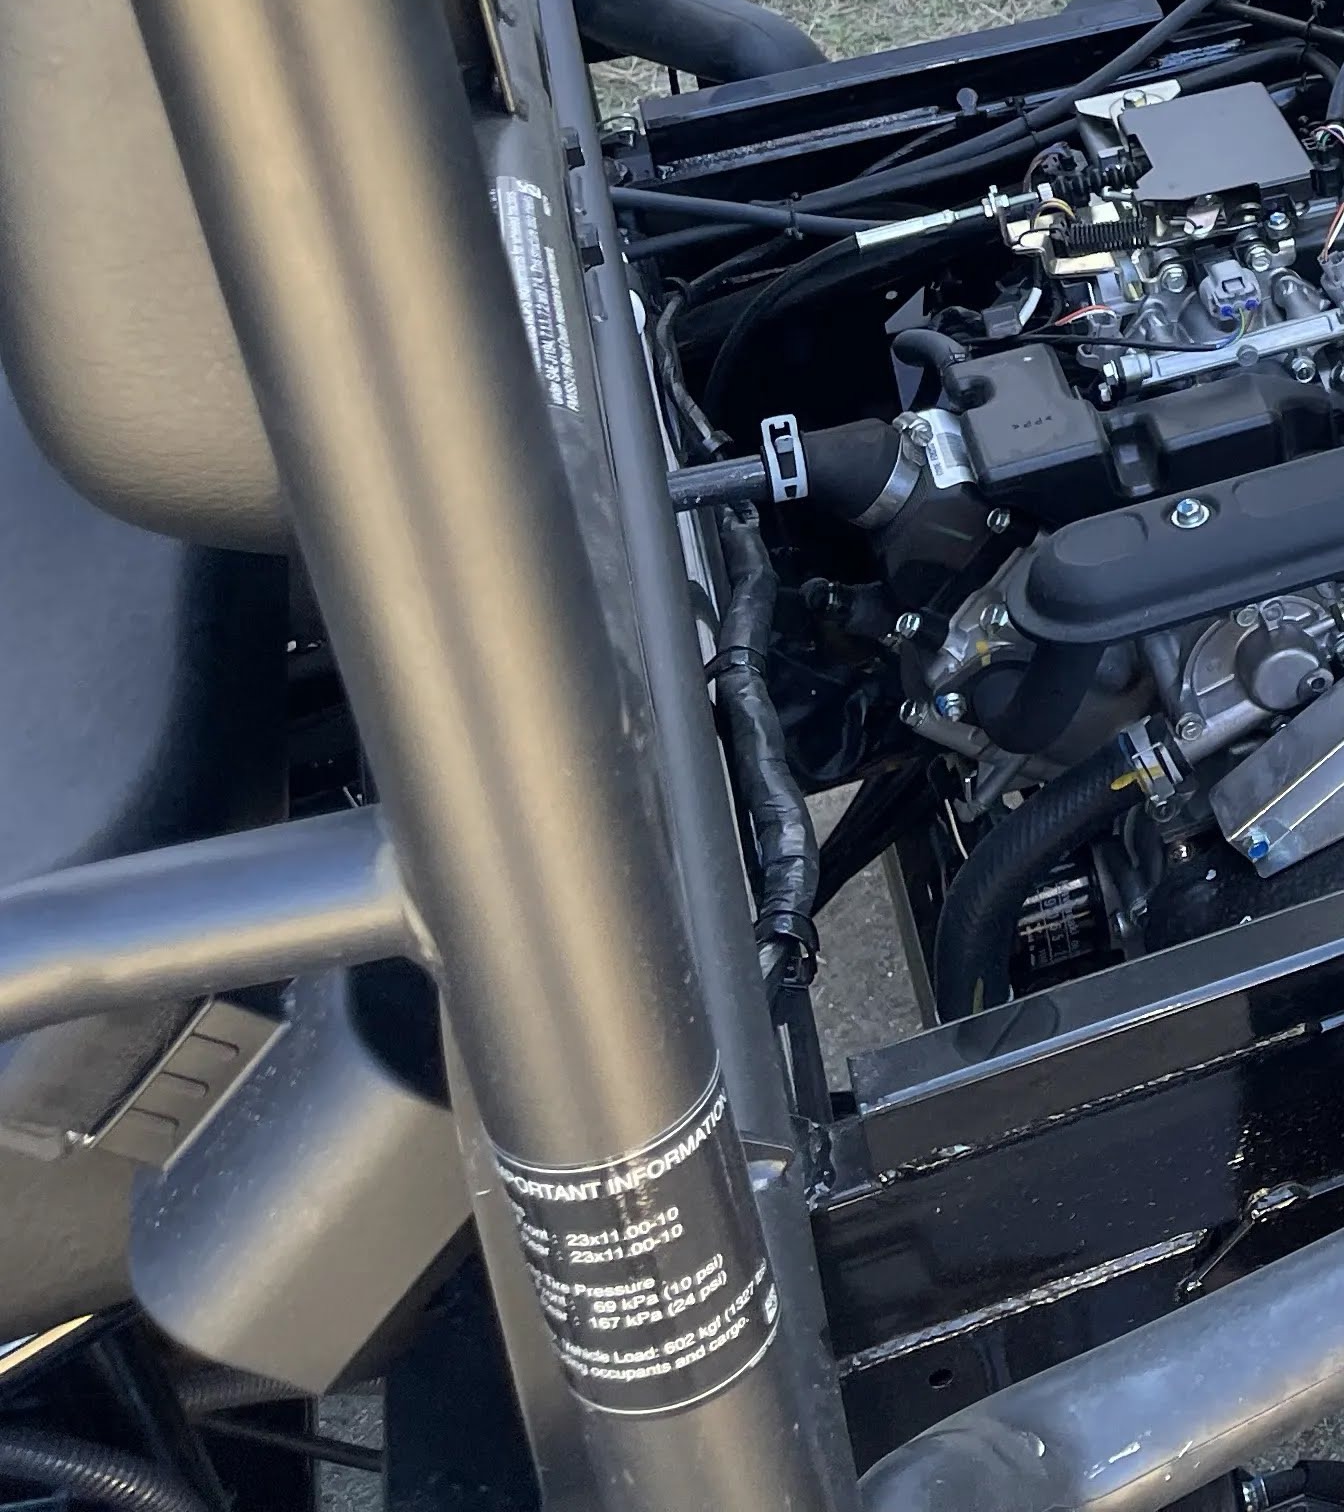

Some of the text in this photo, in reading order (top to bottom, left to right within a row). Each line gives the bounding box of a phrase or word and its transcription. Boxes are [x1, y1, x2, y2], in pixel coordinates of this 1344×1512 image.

[498, 1165, 602, 1201] PORTANT
[565, 1206, 680, 1247] 23x11.00-10
[569, 1223, 684, 1264] 23x11.00-10
[574, 1276, 656, 1298] Pressure
[589, 1315, 620, 1331] 167
[626, 1308, 664, 1328] kPa
[667, 1291, 696, 1317] (24
[698, 1270, 728, 1300] psi)
[593, 1299, 617, 1314] 69
[622, 1291, 659, 1311] kPa
[663, 1276, 692, 1301] (10
[694, 1253, 724, 1284] psi)
[590, 1362, 672, 1383] occupants
[675, 1348, 707, 1368] and
[708, 1316, 750, 1352] cargo.
[613, 1346, 660, 1364] Load:
[663, 1332, 695, 1355] 602
